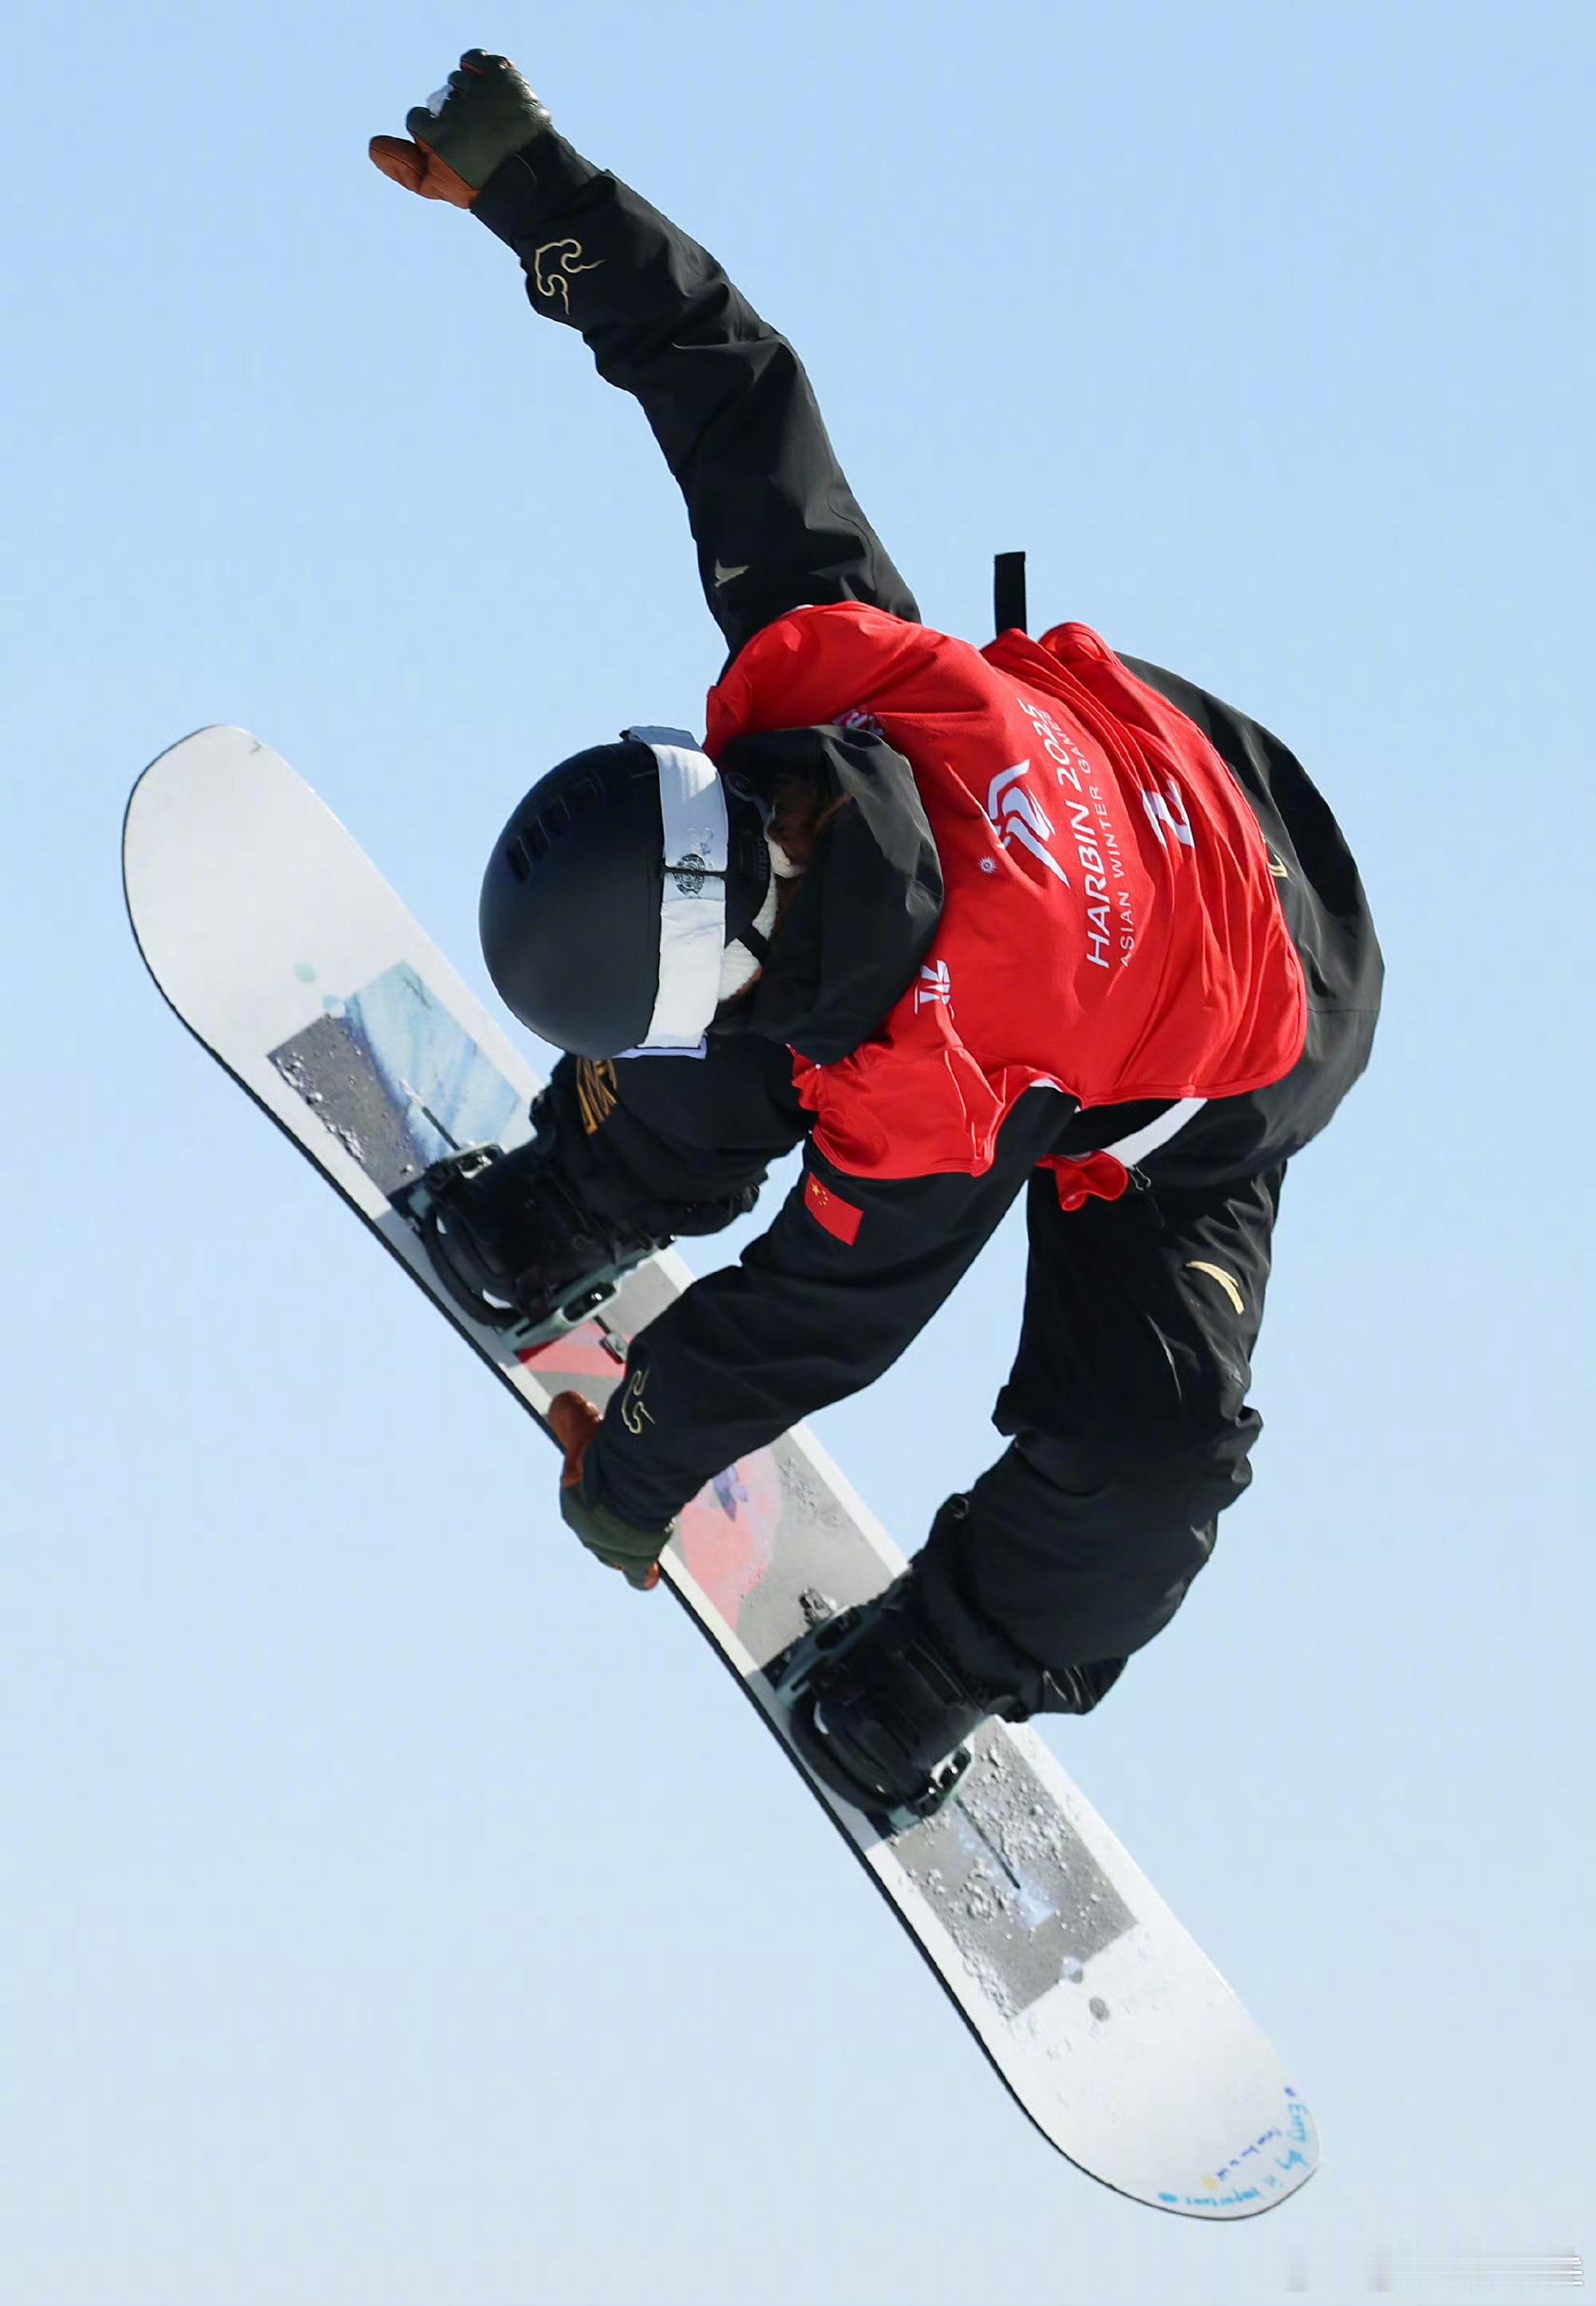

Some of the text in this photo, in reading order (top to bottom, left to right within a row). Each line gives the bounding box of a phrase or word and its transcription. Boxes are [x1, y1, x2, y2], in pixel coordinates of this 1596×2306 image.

[1017, 698, 1110, 968] HARBIN 2025
[1090, 785, 1125, 879] WINTER
[1117, 890, 1136, 967] ASIAN
